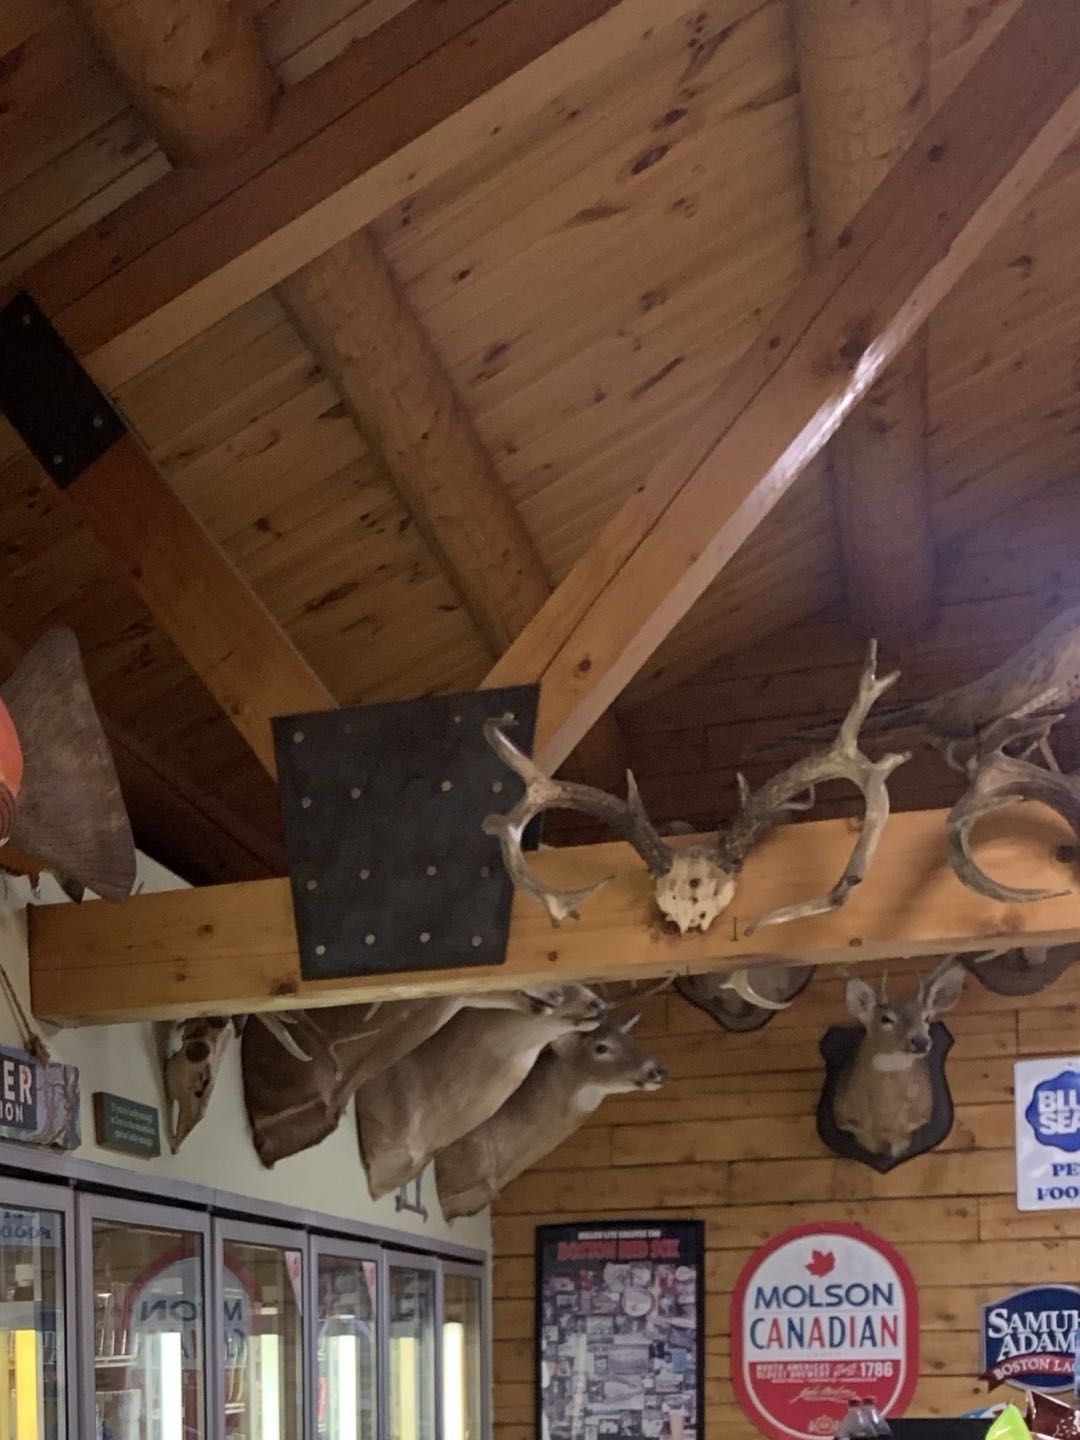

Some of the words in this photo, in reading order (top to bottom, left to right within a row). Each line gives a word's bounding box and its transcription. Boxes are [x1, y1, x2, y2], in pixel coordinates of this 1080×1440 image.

[1039, 1110, 1080, 1136] SEA
[1052, 1162, 1080, 1178] PE
[1037, 1185, 1080, 1201] FOO
[754, 1282, 894, 1309] MOLSON
[750, 1314, 898, 1349] CANADIAN
[996, 1332, 1076, 1362] ADAM
[860, 1361, 893, 1378] 1786
[993, 1357, 1051, 1380] BOSTON
